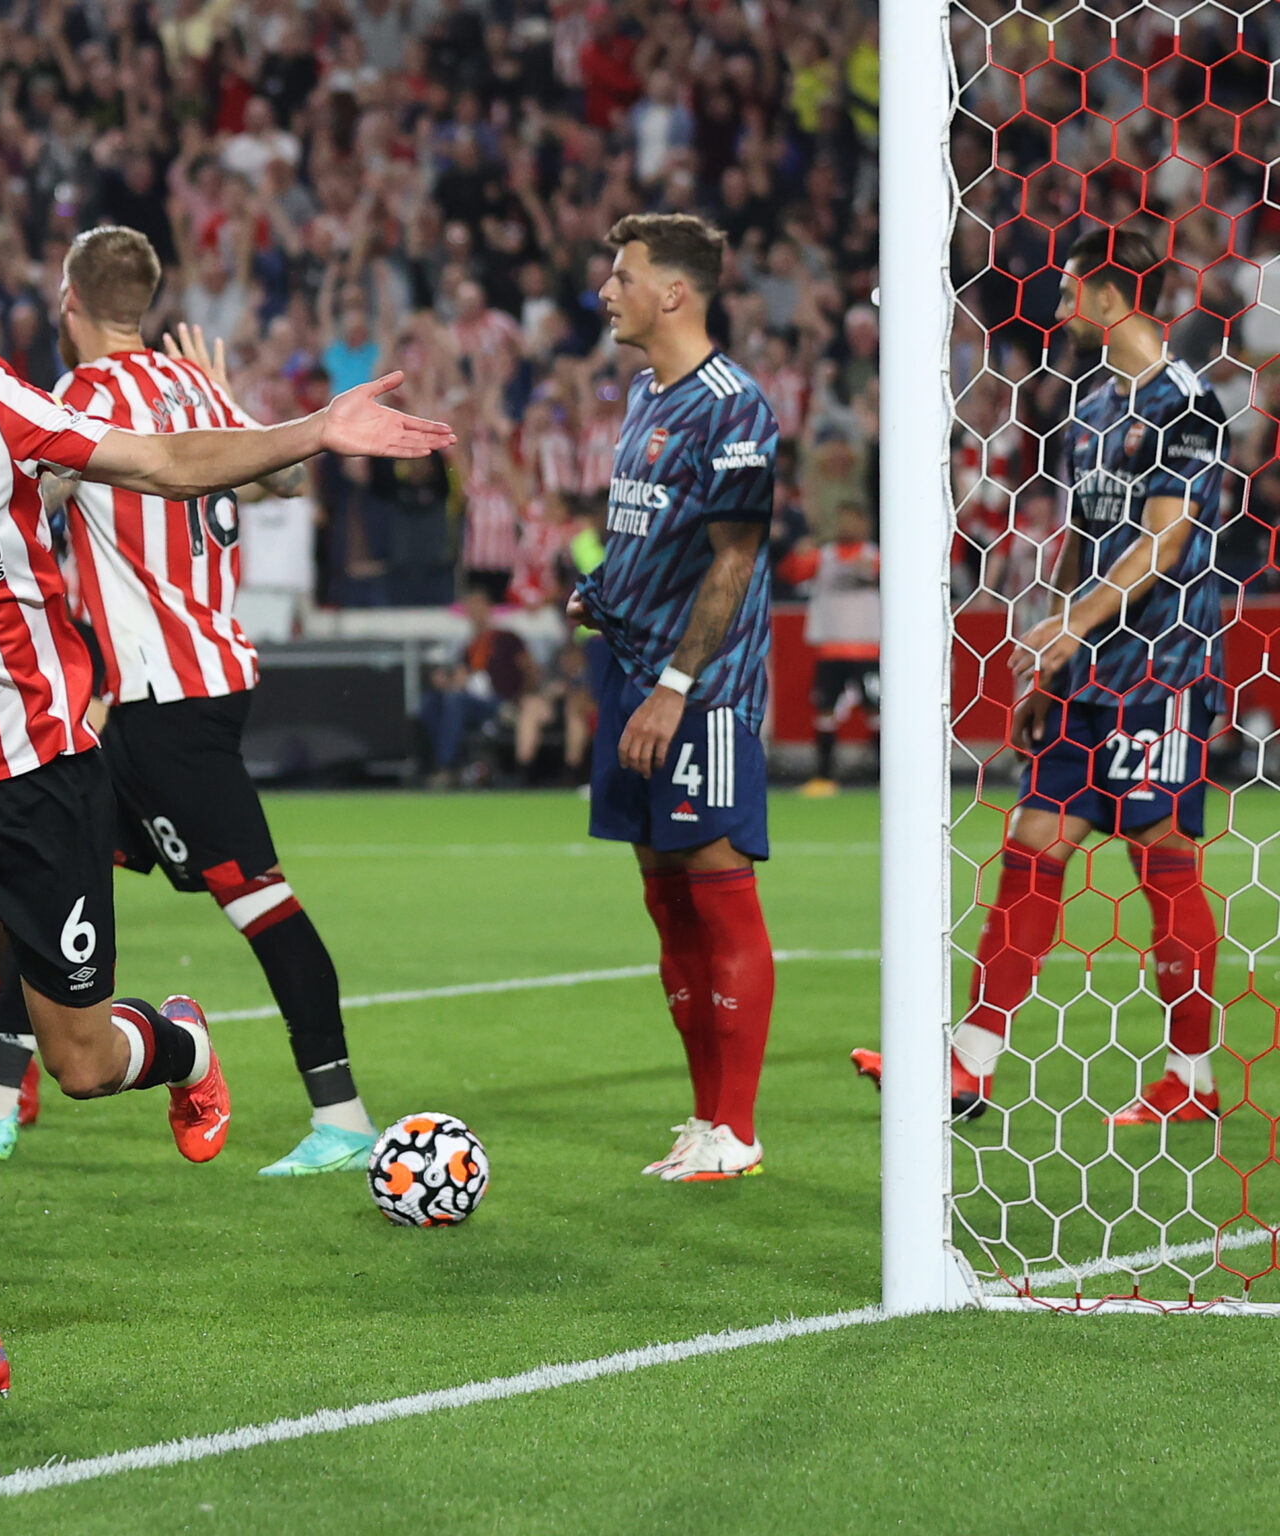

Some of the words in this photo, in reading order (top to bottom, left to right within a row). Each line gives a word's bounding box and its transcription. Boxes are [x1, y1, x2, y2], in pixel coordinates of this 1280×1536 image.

[712, 453, 768, 471] RWANDA
[723, 441, 756, 456] VISIT
[608, 471, 670, 510] mirates
[672, 742, 704, 796] 4
[1105, 728, 1161, 780] 22
[60, 895, 97, 964] 6
